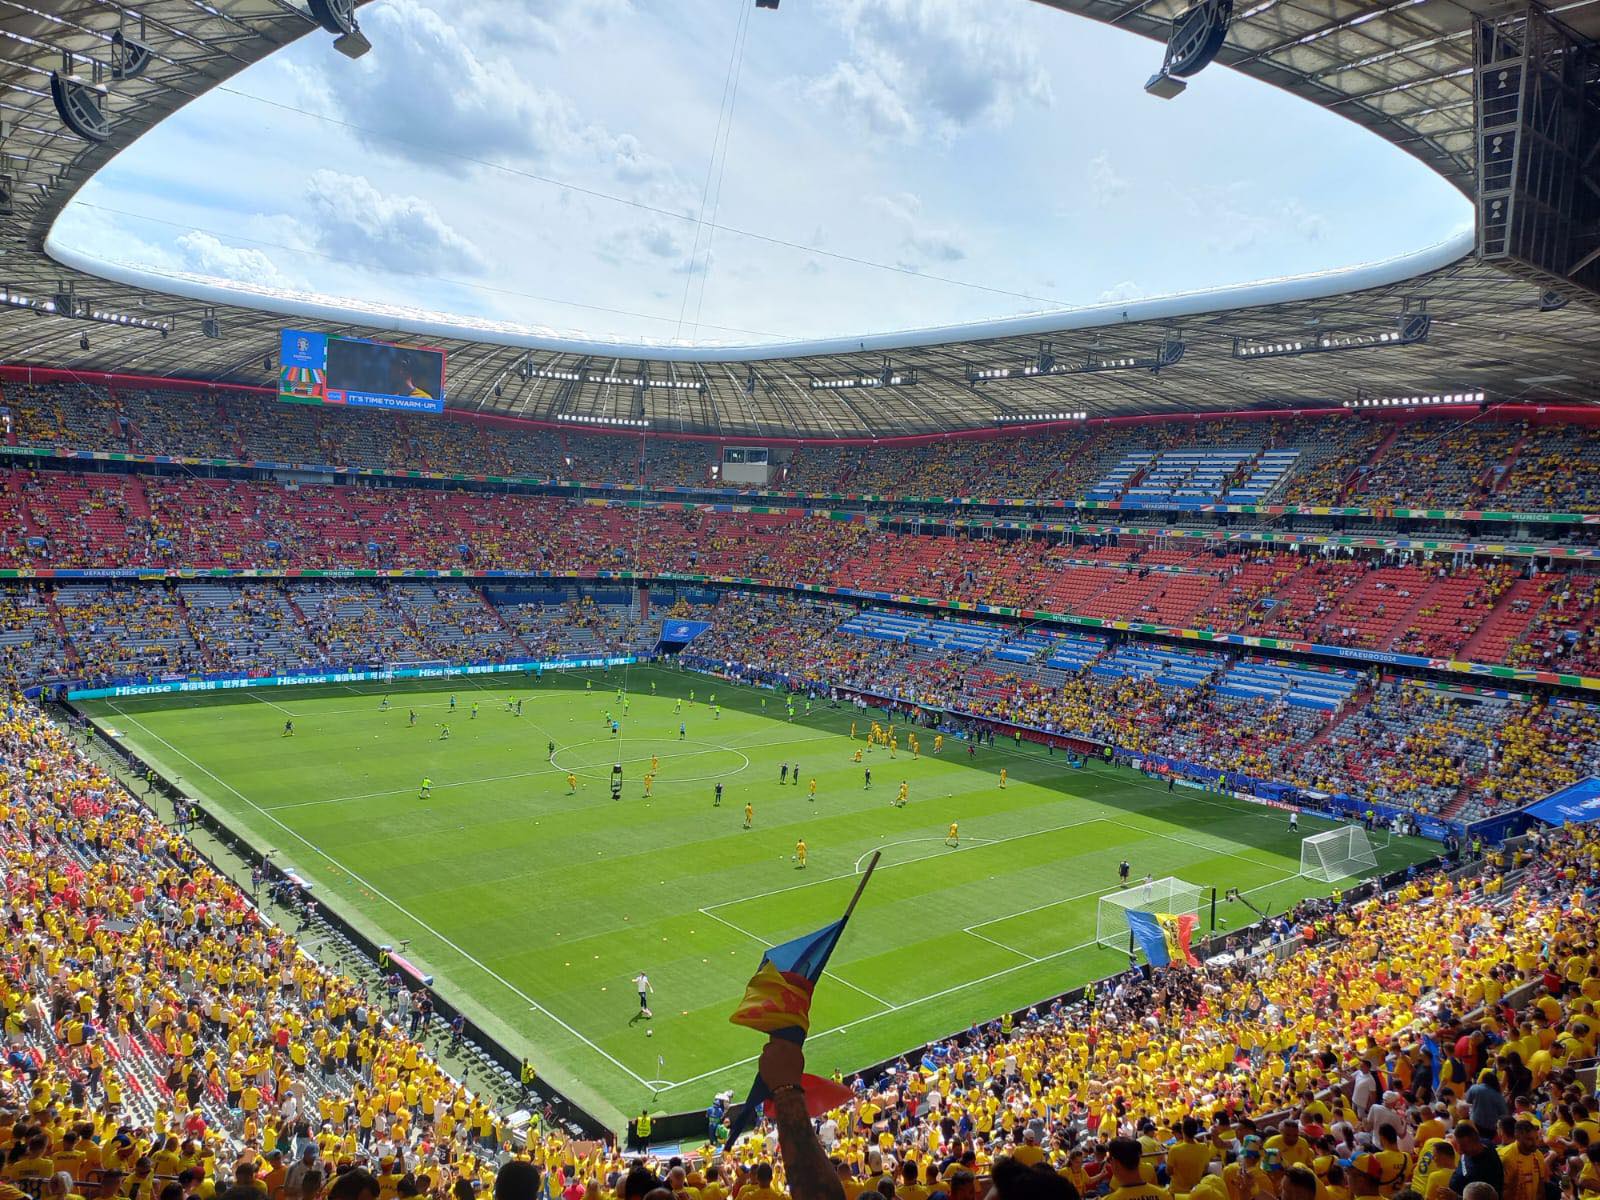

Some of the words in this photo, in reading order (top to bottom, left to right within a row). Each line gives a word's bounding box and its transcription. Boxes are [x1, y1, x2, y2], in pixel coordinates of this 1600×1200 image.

[349, 395, 363, 403] IT'S
[396, 399, 436, 409] WARM-UP!
[115, 685, 171, 696] Hisense
[277, 675, 326, 685] Hisense
[540, 661, 576, 669] Hisense
